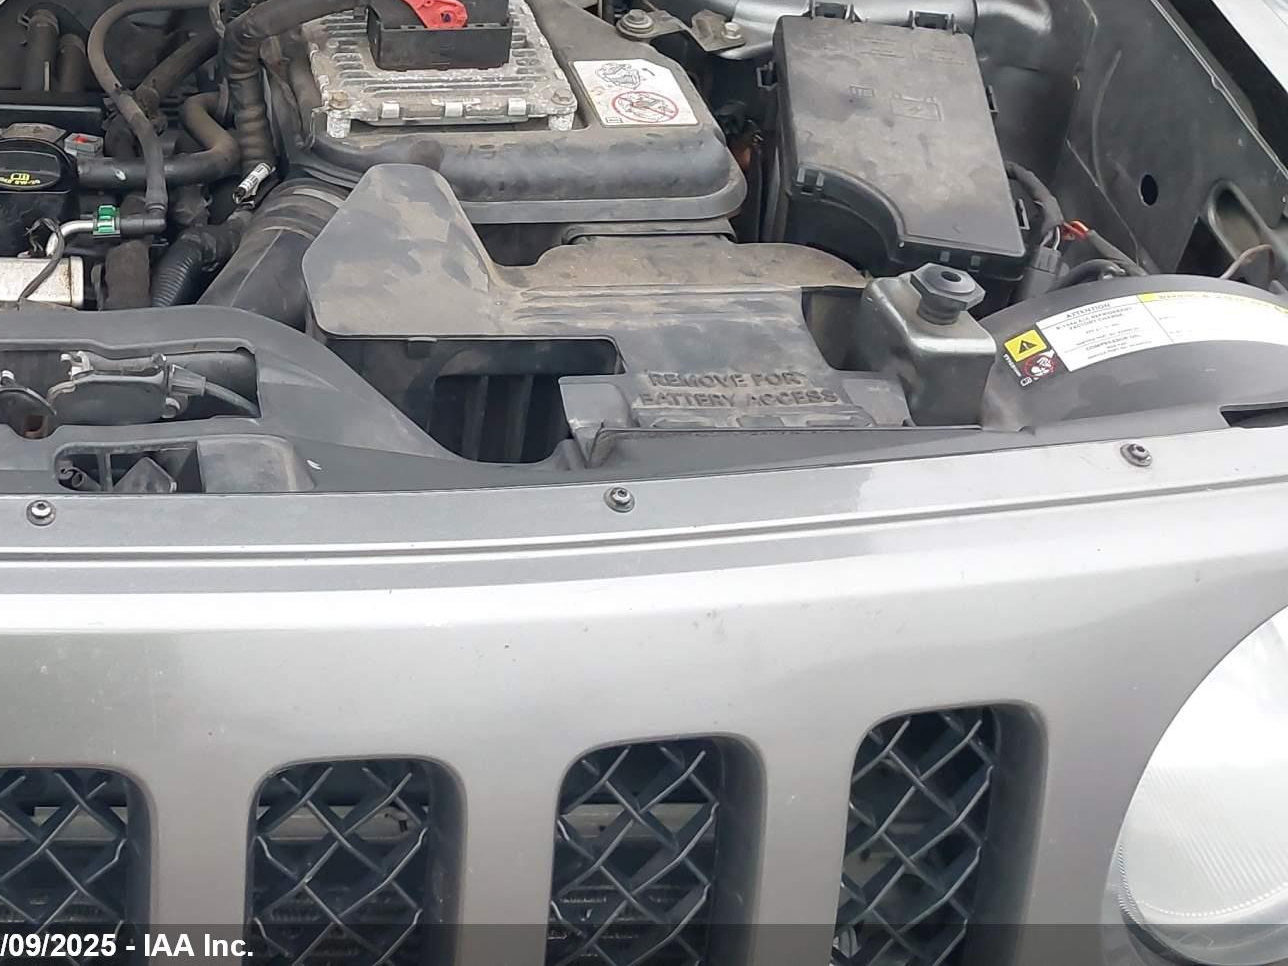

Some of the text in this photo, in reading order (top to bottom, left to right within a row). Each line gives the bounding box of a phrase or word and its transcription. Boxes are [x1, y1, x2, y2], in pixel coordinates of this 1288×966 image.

[1066, 303, 1111, 318] ATTENTION
[648, 371, 803, 388] REMOVE FOR
[639, 388, 839, 407] BATTERY ACCESS
